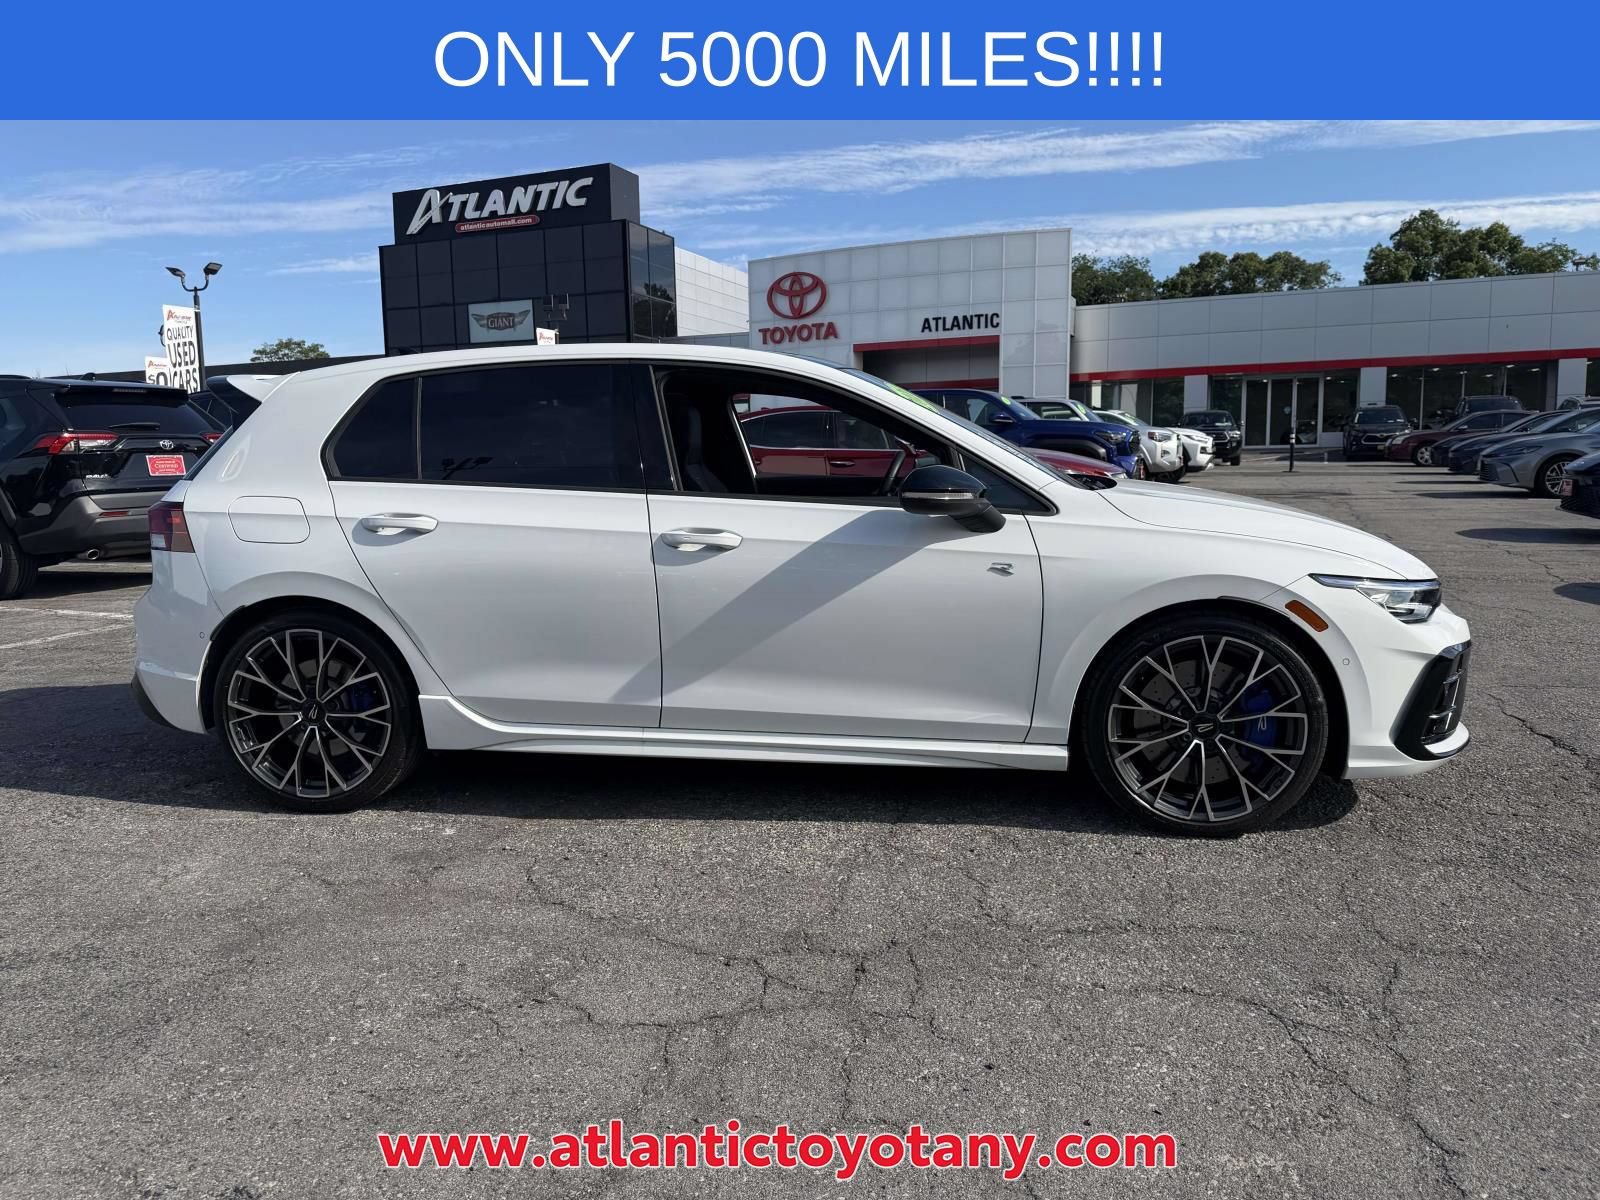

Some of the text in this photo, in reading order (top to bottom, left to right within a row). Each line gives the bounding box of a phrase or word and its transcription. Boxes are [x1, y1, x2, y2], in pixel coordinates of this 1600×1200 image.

[406, 177, 593, 235] ATLANTIC
[460, 218, 532, 231] atlanticautomall.com
[166, 325, 194, 341] QUALITY
[488, 316, 513, 328] GIANT
[758, 321, 839, 345] TOYOTA
[921, 312, 1001, 333] ATLANTIC
[167, 340, 196, 368] USED
[172, 367, 198, 393] CARS
